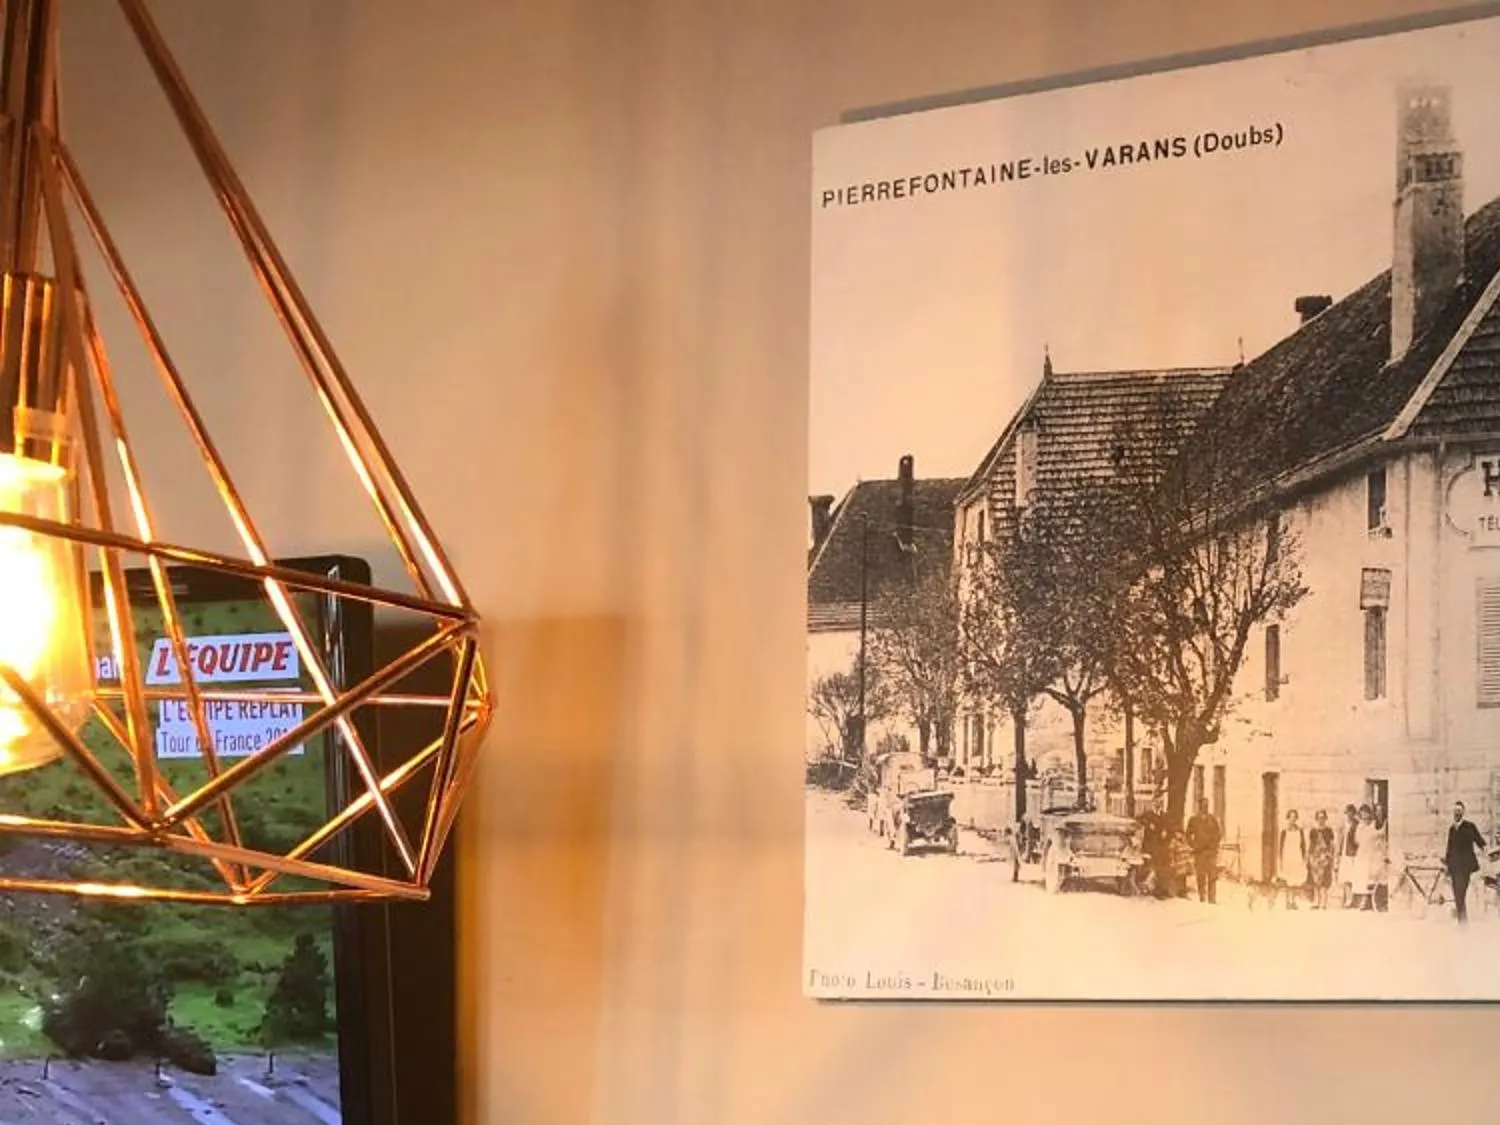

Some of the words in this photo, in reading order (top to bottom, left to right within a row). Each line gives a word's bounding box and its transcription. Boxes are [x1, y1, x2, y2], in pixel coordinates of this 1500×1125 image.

[821, 137, 1186, 208] PIERREFONTAINE-les-VARANS
[1193, 122, 1284, 158] (Doubs)
[239, 699, 298, 720] REPLAY
[162, 731, 191, 753] Tour
[215, 729, 261, 752] France
